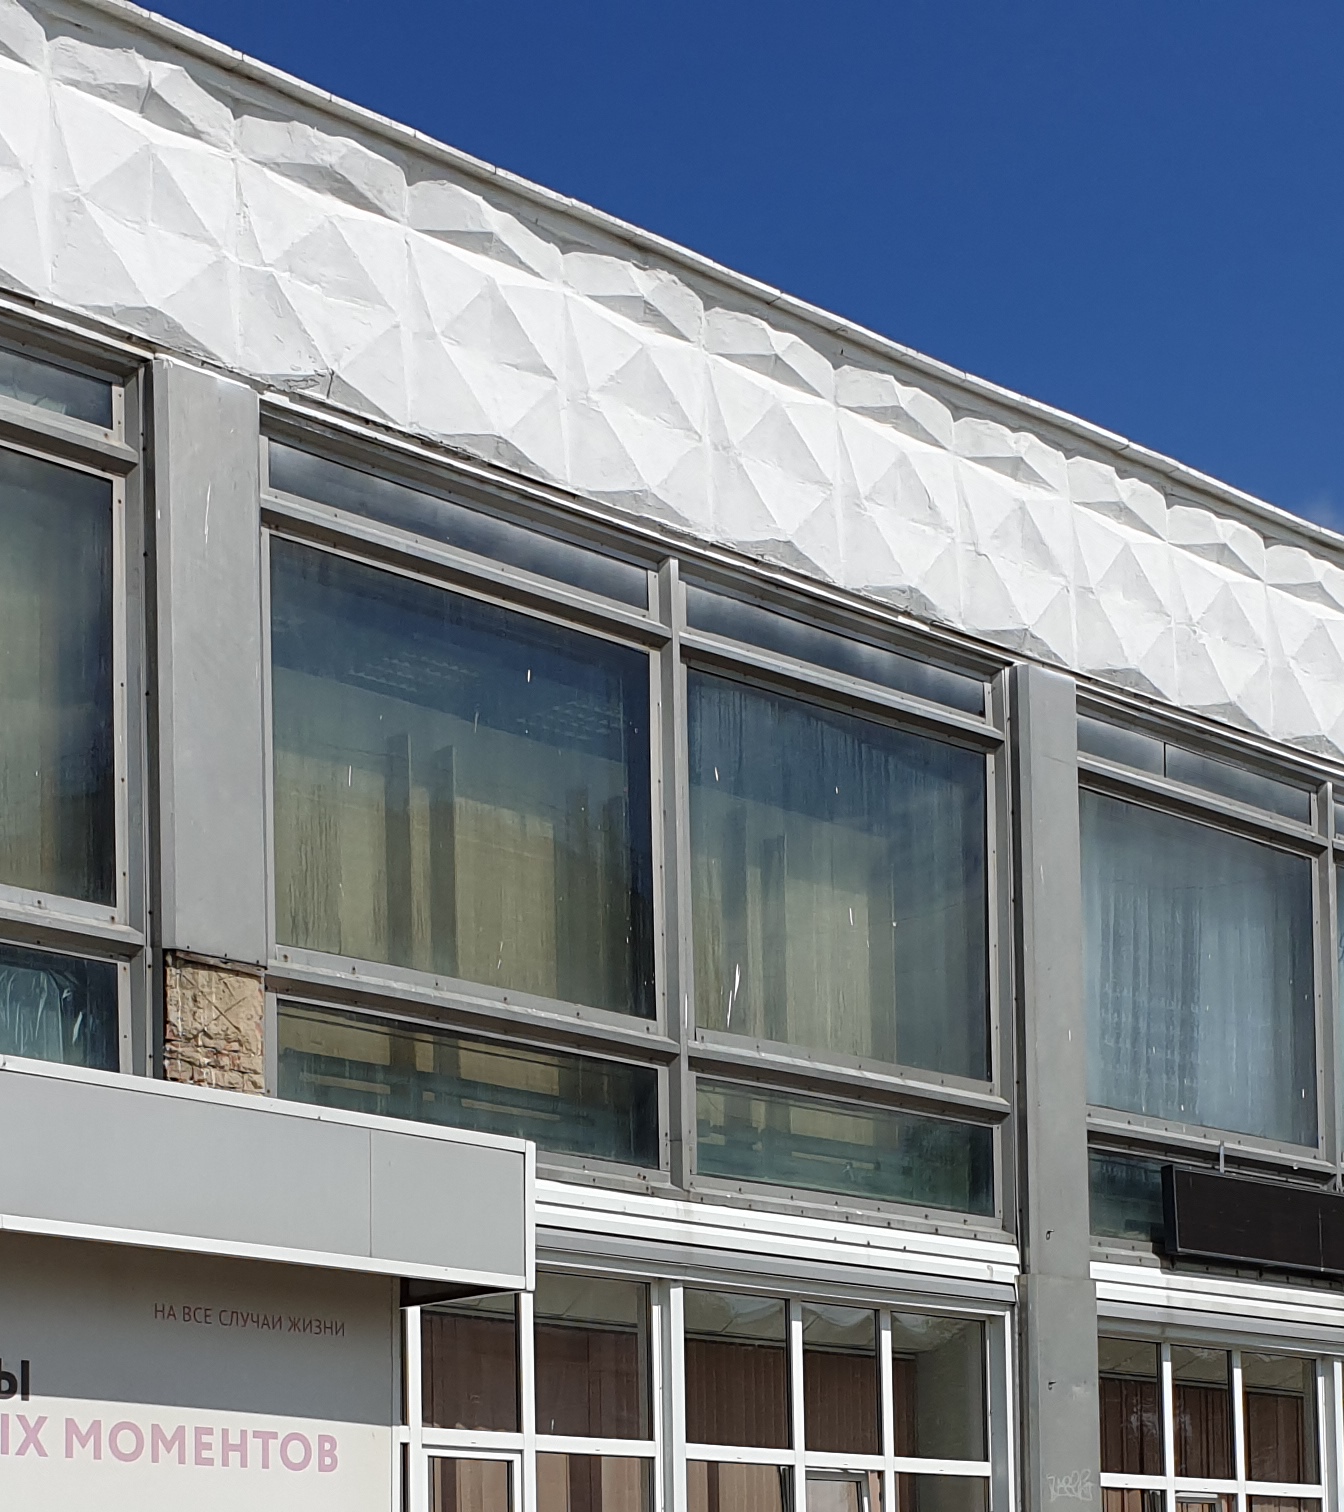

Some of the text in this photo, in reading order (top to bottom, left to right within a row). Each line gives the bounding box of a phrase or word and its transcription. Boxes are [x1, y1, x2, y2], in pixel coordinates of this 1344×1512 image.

[154, 1303, 345, 1337] НА ВСЕ СЛУЧАИ ЖИЗНИ
[64, 1417, 339, 1473] МОМЕНТОВ
